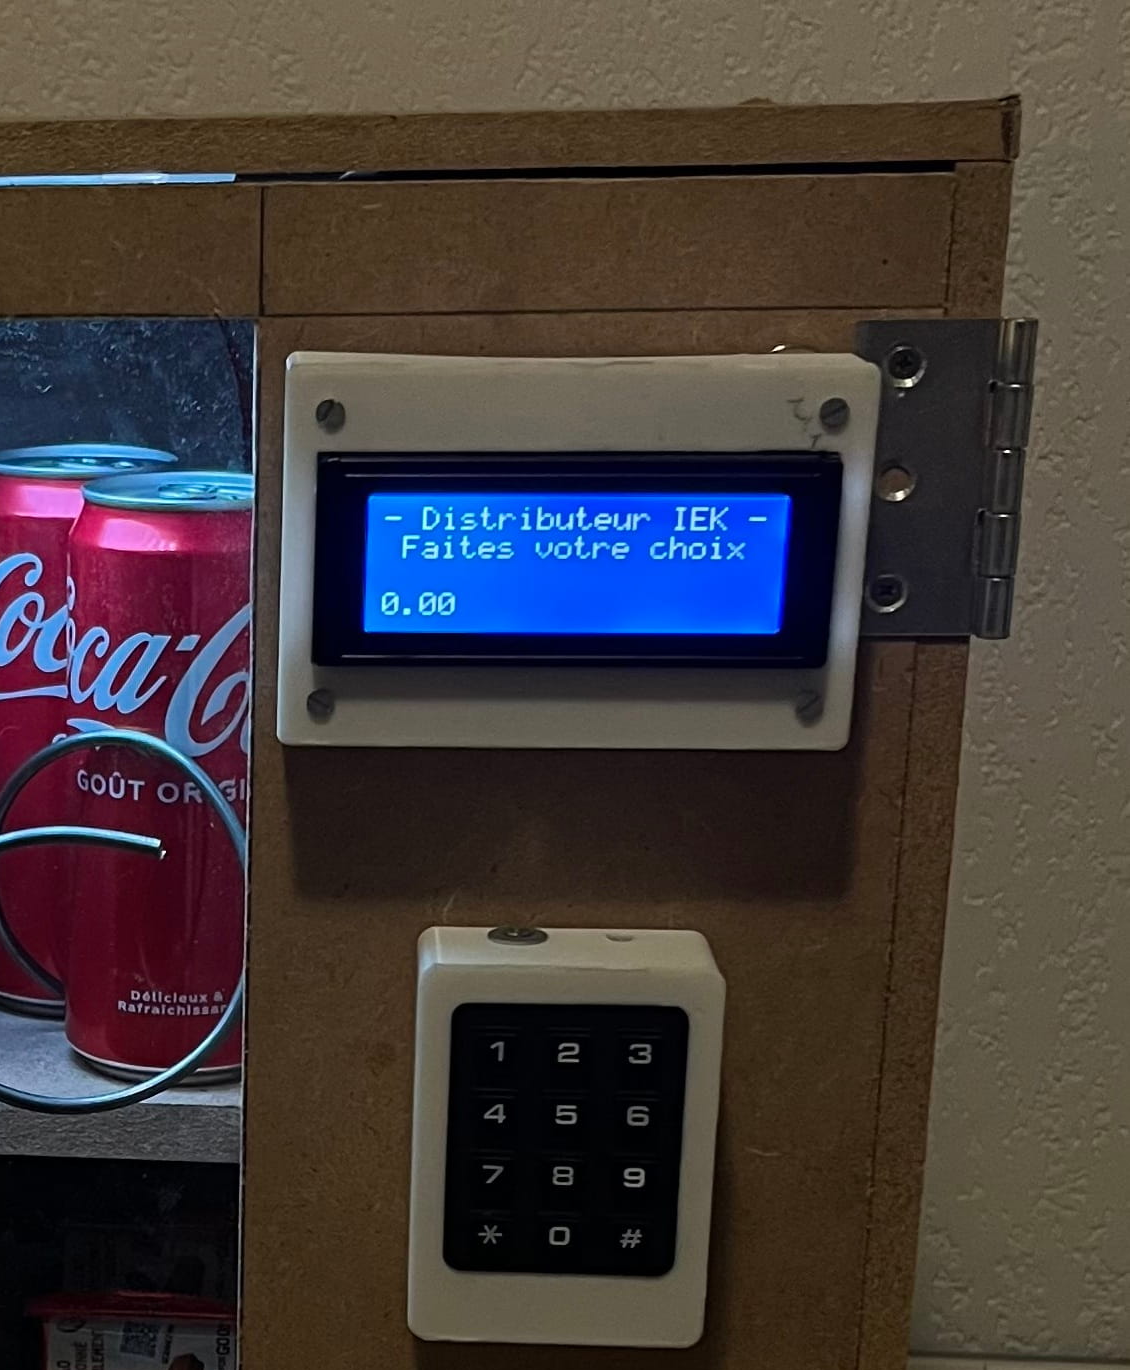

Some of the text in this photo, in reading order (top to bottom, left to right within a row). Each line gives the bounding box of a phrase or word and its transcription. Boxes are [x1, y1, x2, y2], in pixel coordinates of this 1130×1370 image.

[421, 506, 651, 532] Distributeur
[673, 506, 729, 532] IEK
[402, 535, 746, 561] Faites votre choix
[380, 591, 456, 617] 0.00
[76, 768, 146, 802] GOÛT
[130, 989, 208, 1005] Délicieux
[489, 1041, 653, 1065] 1 2 3
[483, 1103, 651, 1127] 4 5 6
[481, 1165, 646, 1189] 7 8 9
[548, 1226, 571, 1247] 0
